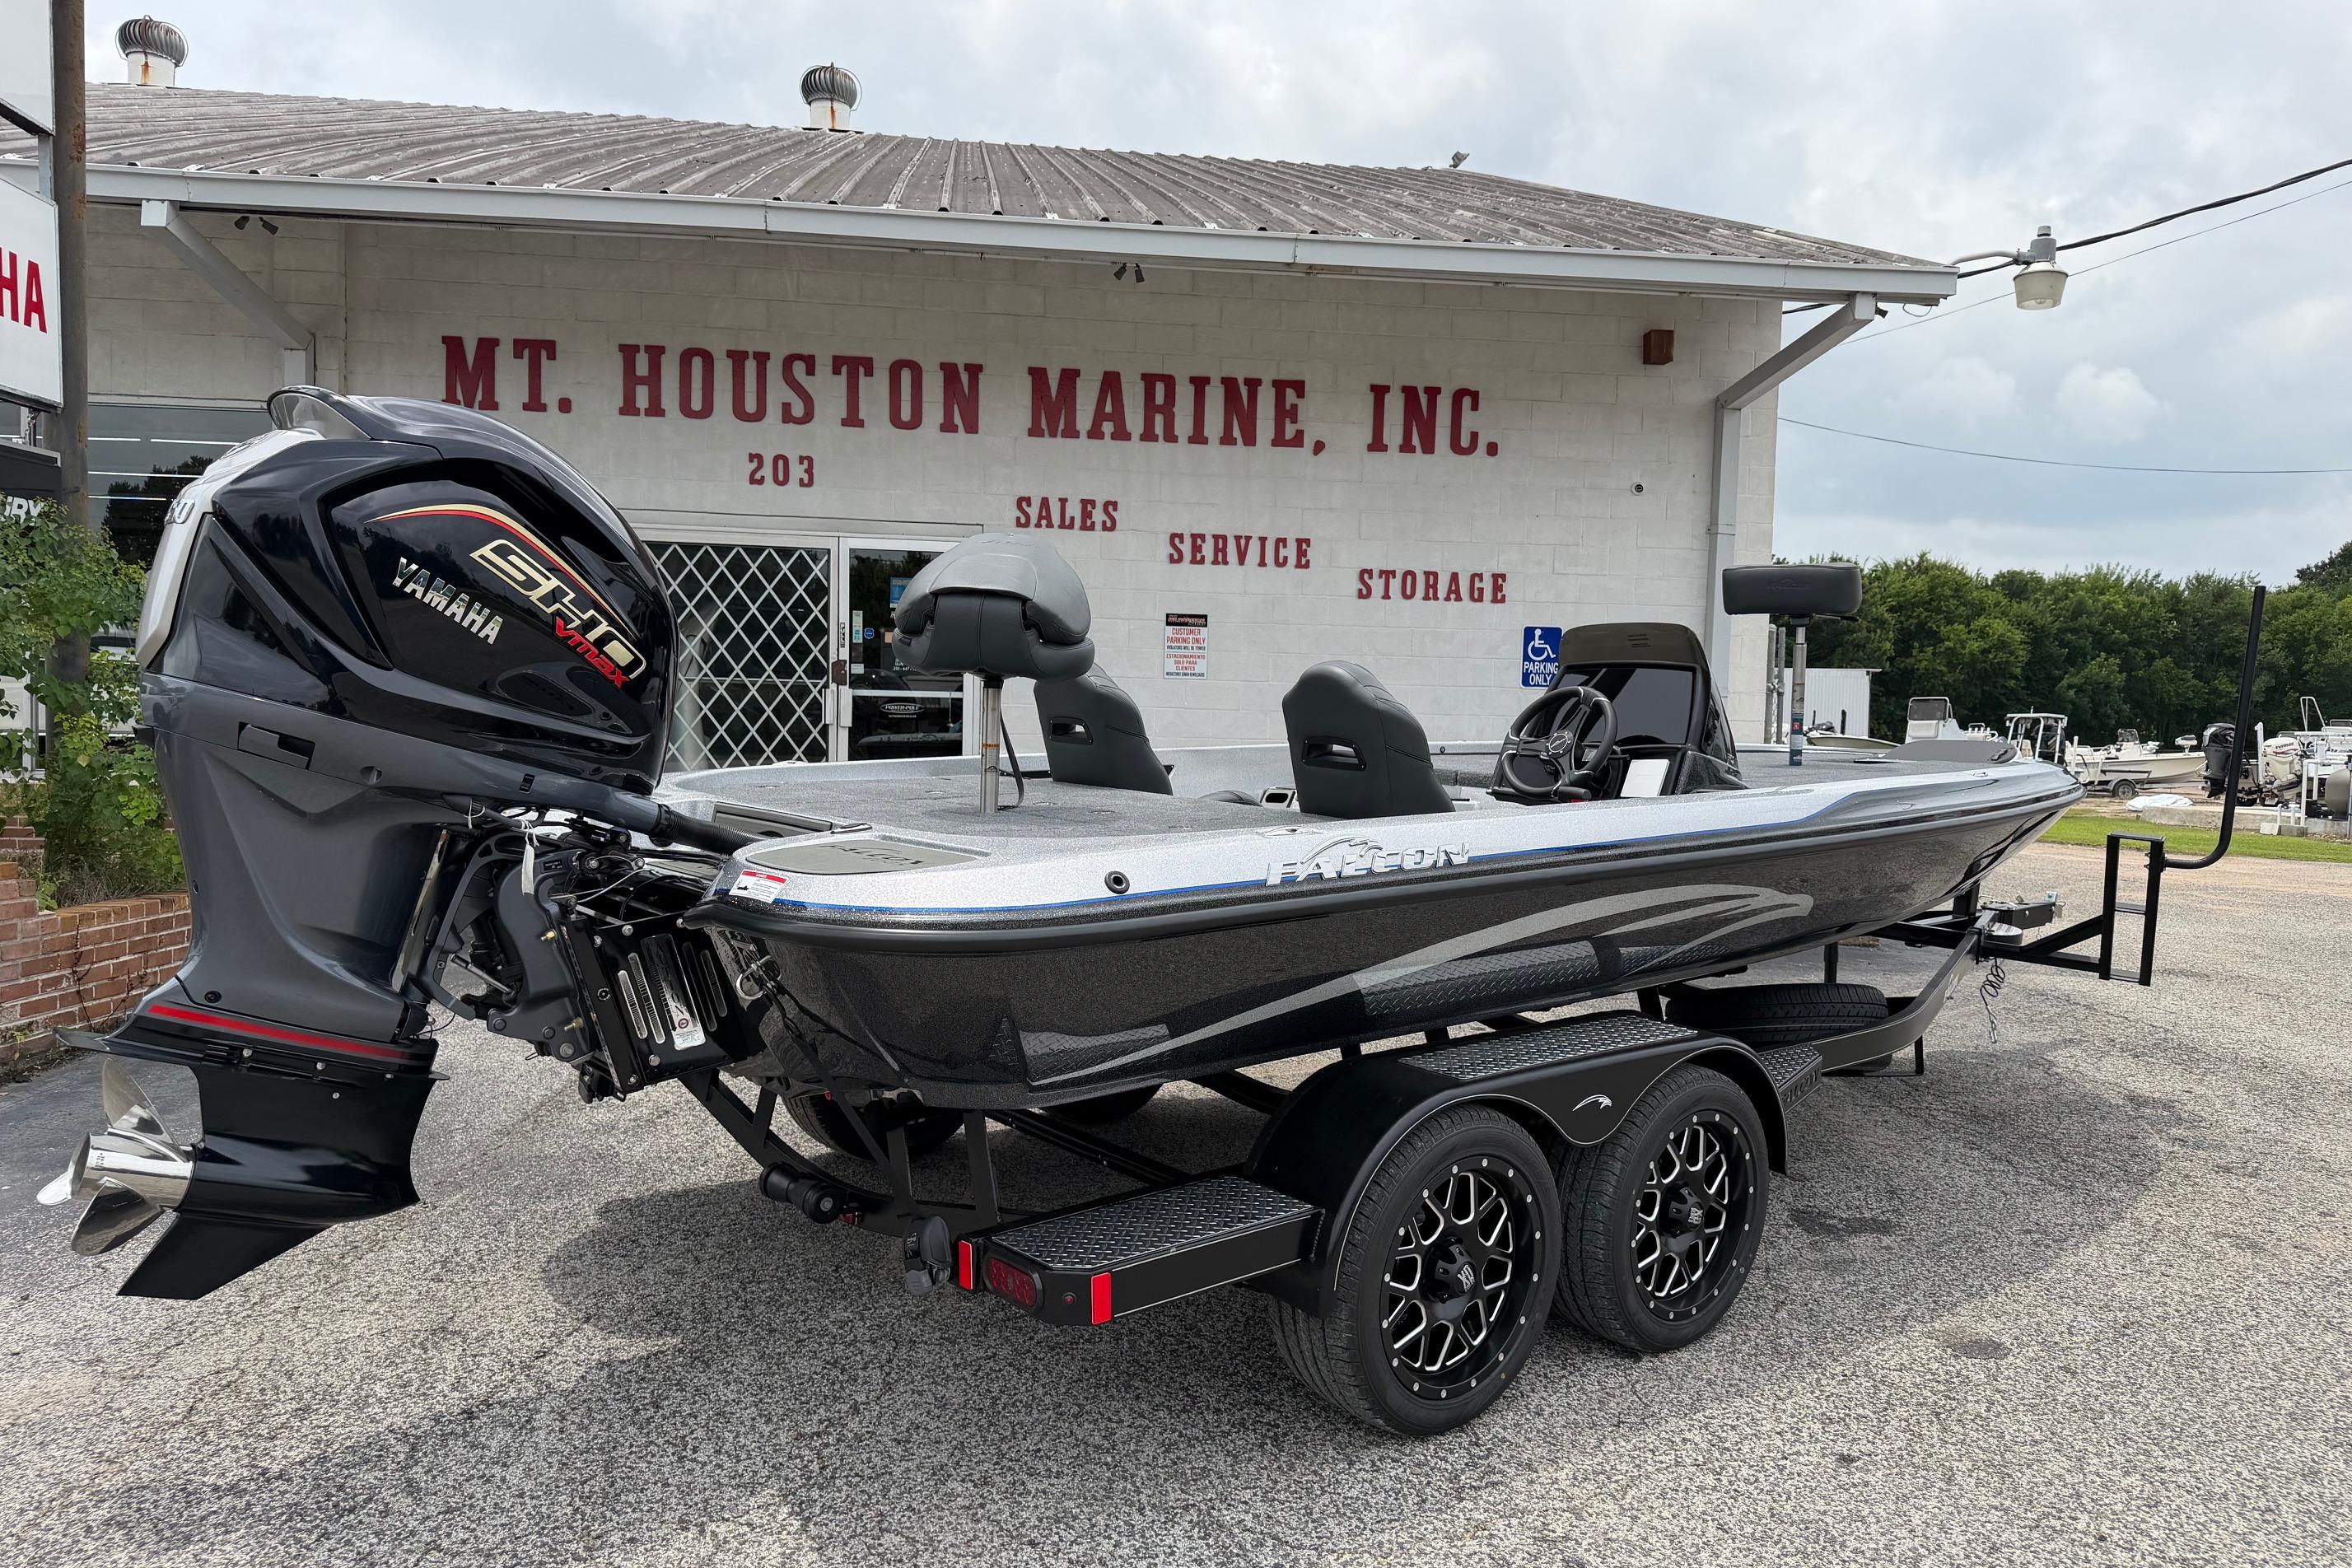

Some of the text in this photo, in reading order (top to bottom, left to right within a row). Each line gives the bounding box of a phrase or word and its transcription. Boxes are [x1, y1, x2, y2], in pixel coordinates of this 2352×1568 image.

[441, 335, 1499, 457] MT. HOUSTON MARINE, INC.
[749, 453, 814, 488] 203
[1015, 497, 1118, 532] SALES
[1169, 532, 1311, 570] SERVICE
[392, 557, 503, 645] YAMAHA
[1358, 568, 1507, 604] STORAGE
[469, 539, 646, 679] SHO
[1166, 636, 1191, 645] PARKING
[1172, 628, 1201, 636] CUSTOMER
[1524, 661, 1559, 674] PARKING
[1529, 674, 1552, 685] ONLY
[1266, 842, 1469, 887] FALCON
